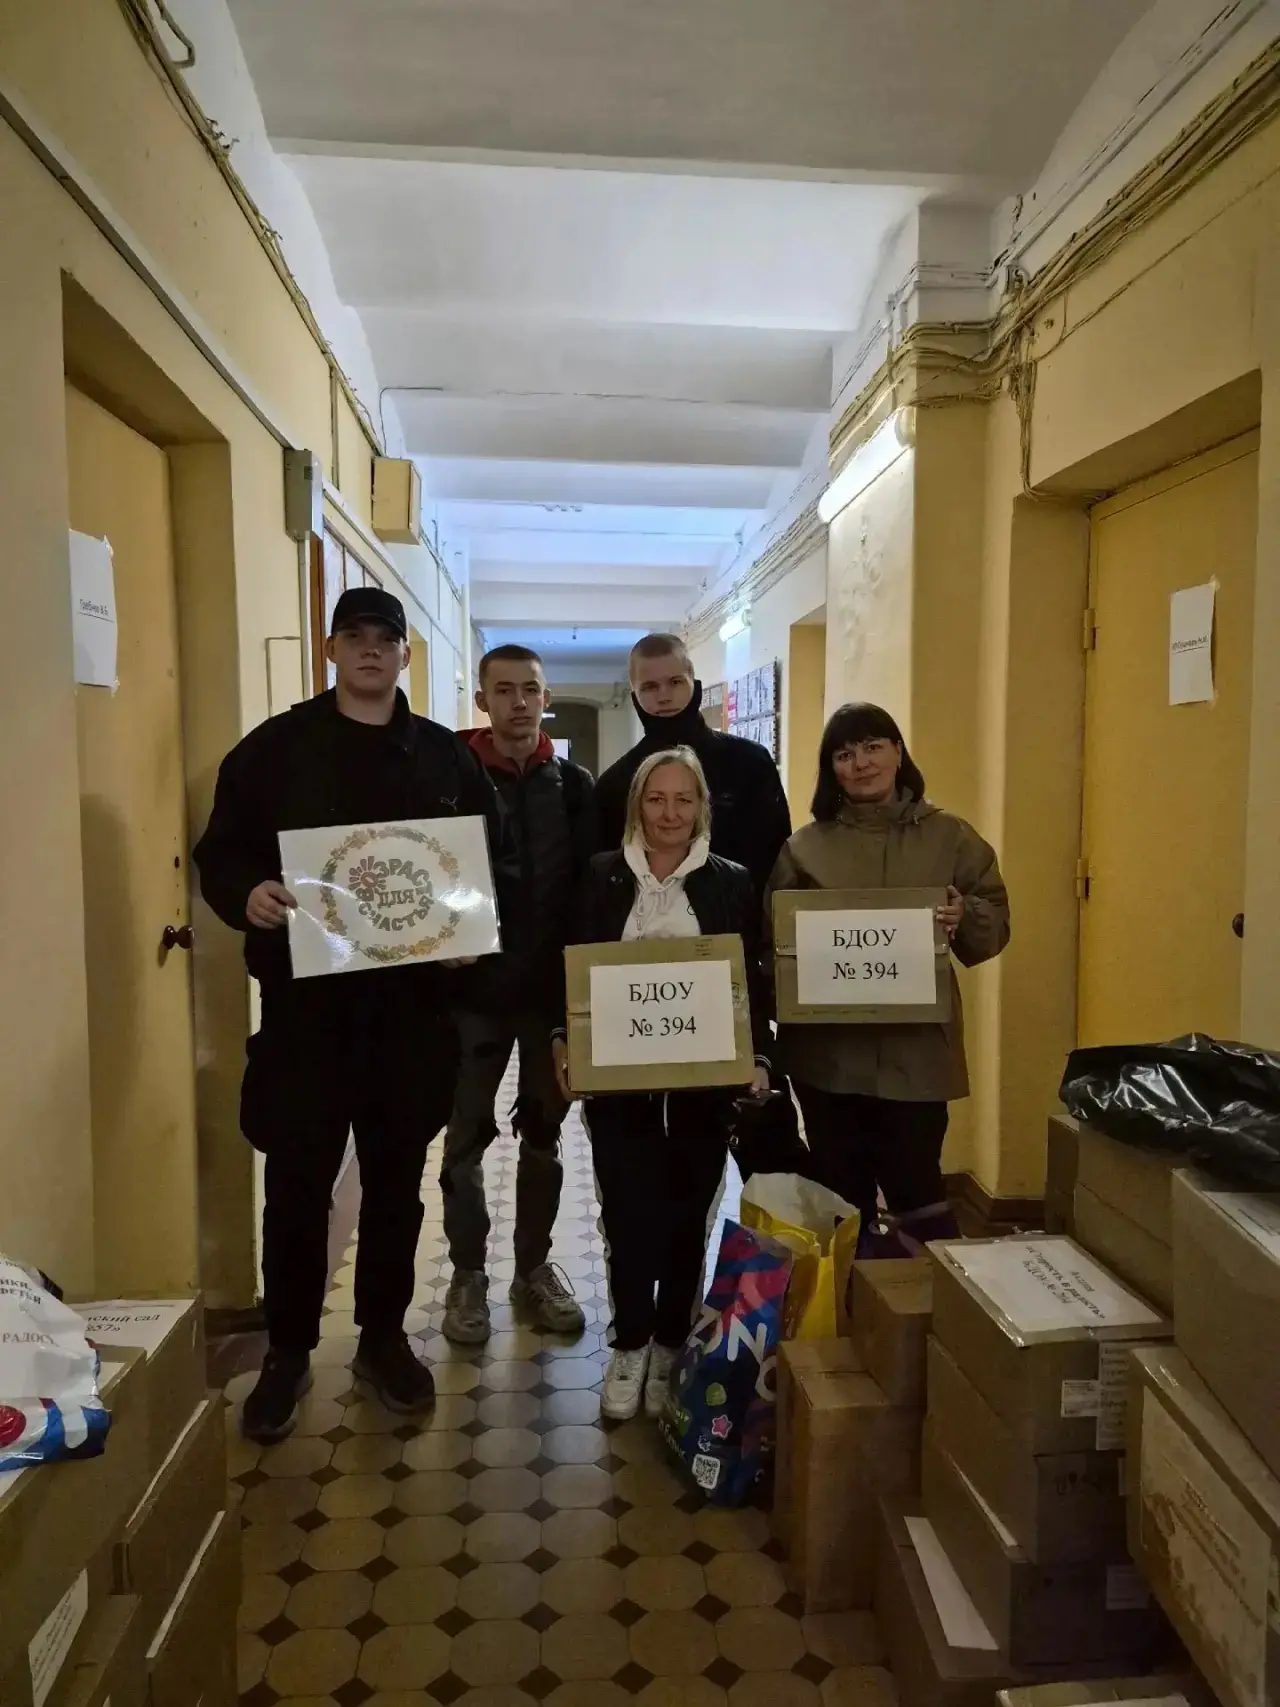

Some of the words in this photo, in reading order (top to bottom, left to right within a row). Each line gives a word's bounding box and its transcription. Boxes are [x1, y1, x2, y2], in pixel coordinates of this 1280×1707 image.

[351, 857, 433, 902] ВОЗРАСТ
[377, 888, 415, 909] ДЛЯ
[358, 895, 435, 932] СЧАСТЬЯ
[832, 928, 897, 950] БДОУ
[832, 962, 856, 980] №
[862, 962, 899, 980] 394
[628, 981, 694, 1005] БДОУ
[628, 1018, 654, 1038] №
[660, 1015, 697, 1036] 394
[133, 1313, 161, 1322] сад
